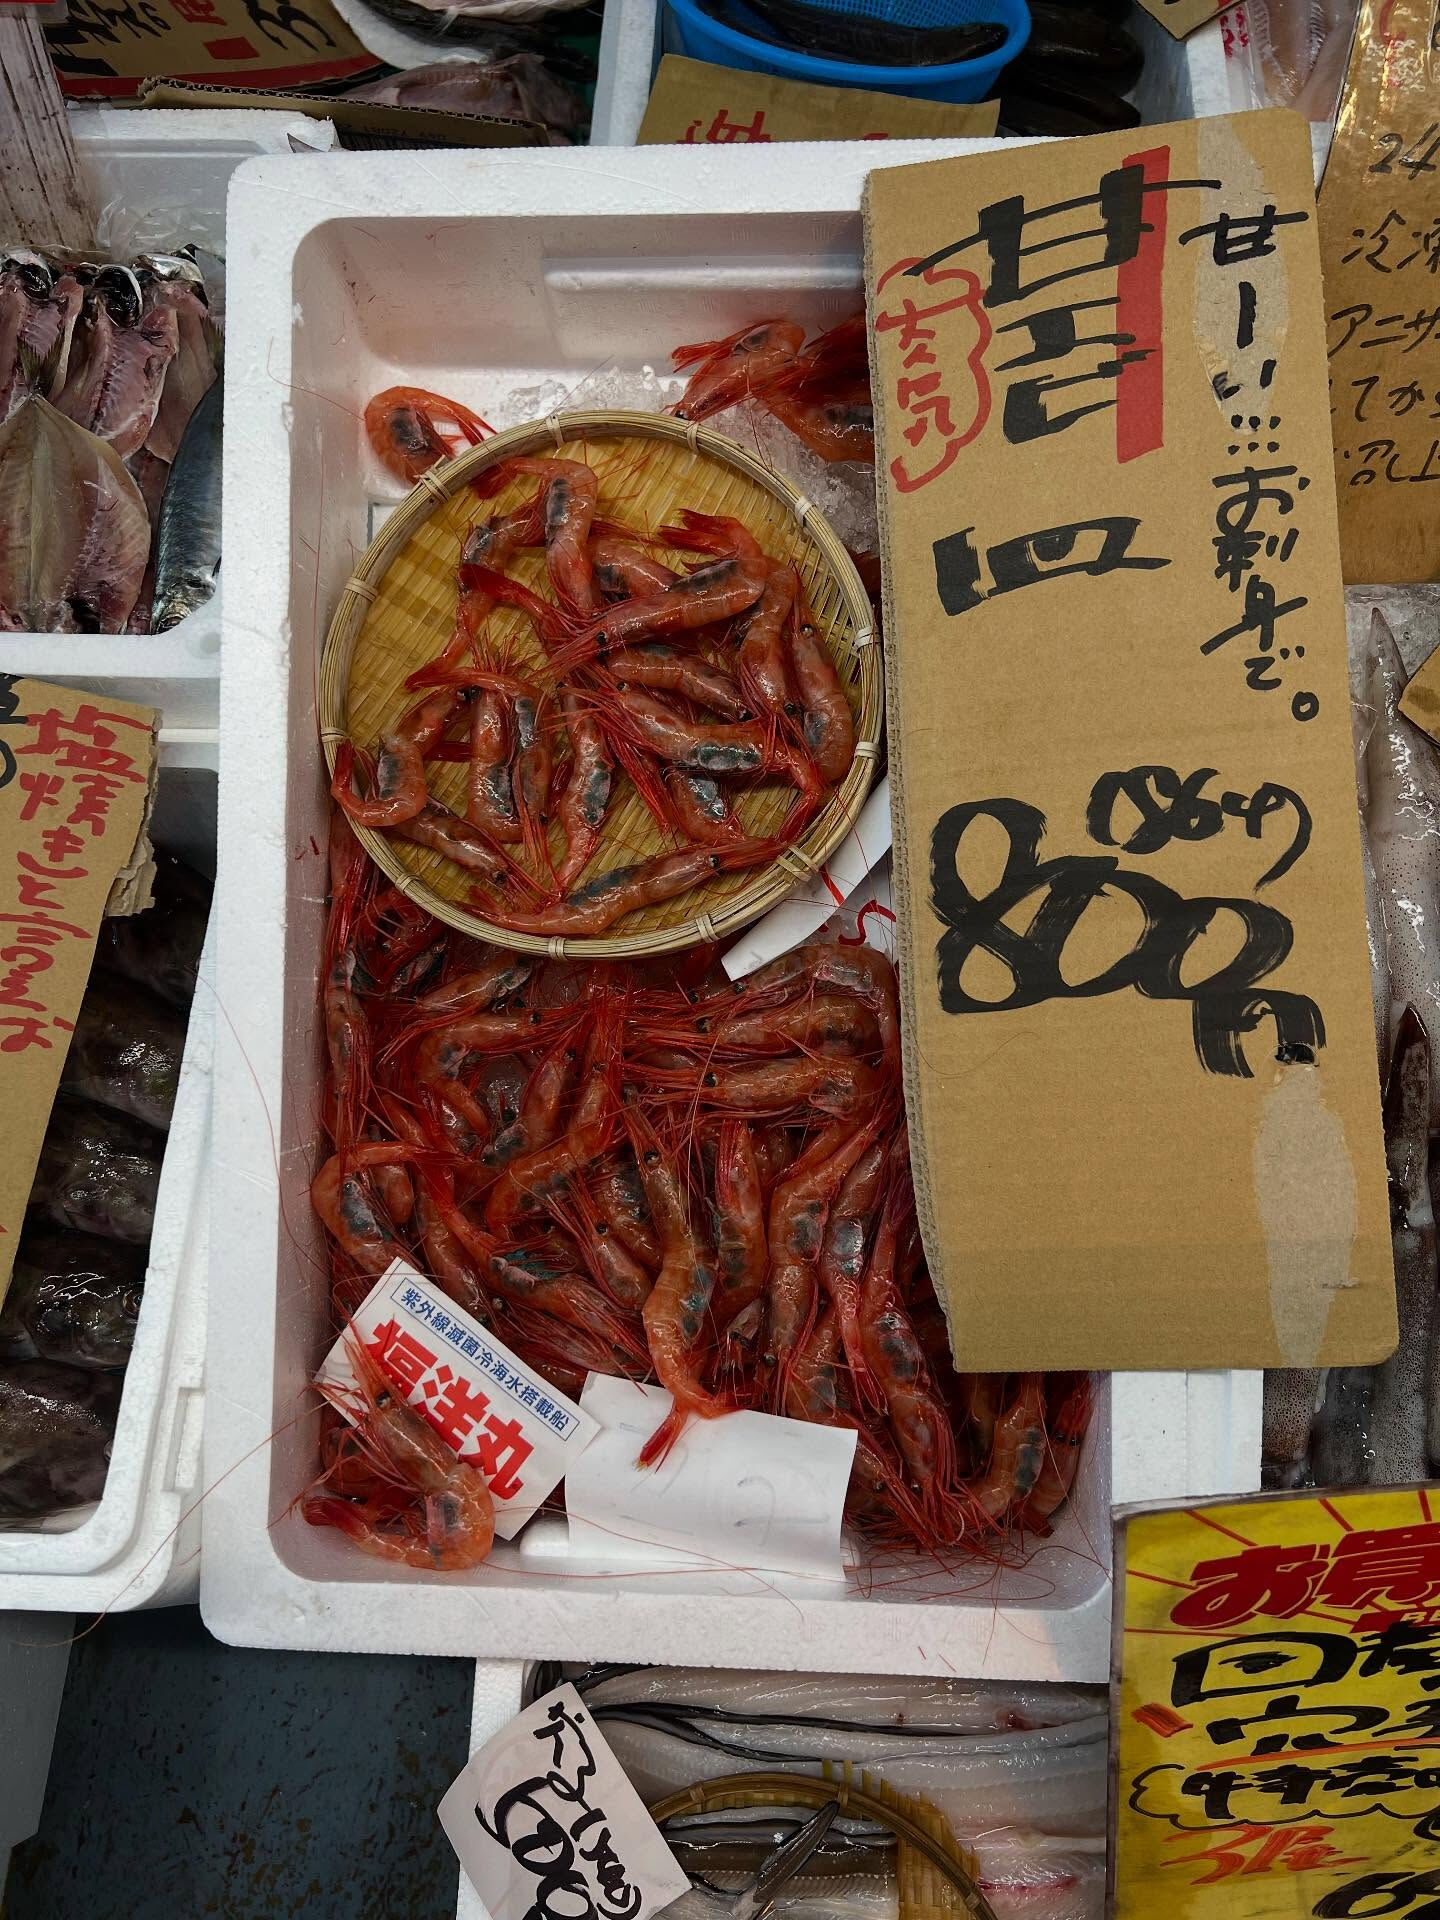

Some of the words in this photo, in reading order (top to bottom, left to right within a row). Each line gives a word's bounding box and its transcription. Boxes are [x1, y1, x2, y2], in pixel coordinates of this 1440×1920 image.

[1328, 303, 1440, 358] アニサ
[1334, 439, 1440, 487] 召し上
[928, 797, 1326, 1079] 800円
[400, 1287, 570, 1432] 紫外線滅菌冷海水搭載船
